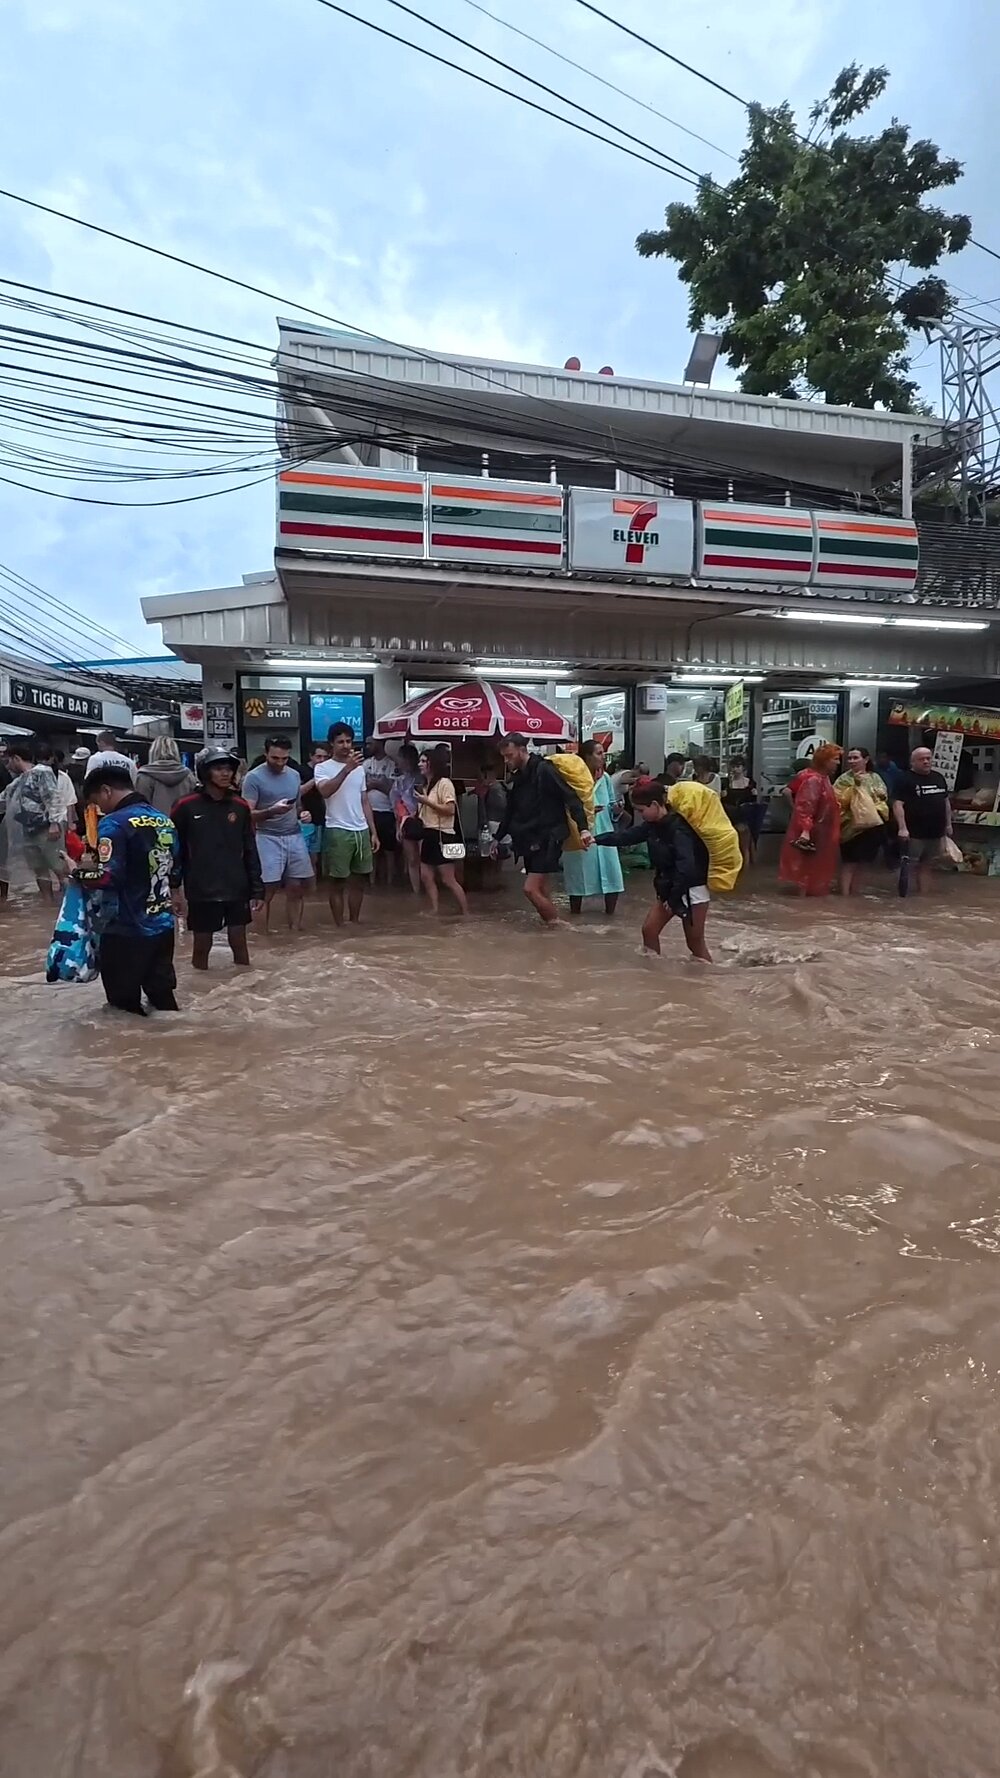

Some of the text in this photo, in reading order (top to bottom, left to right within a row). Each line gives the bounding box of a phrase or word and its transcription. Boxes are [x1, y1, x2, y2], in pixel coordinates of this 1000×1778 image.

[612, 498, 658, 563] 7
[31, 688, 88, 715] TIGER BAR
[809, 704, 836, 713] 03807
[267, 709, 291, 718] atm
[340, 716, 361, 726] ATM
[215, 722, 226, 730] 22
